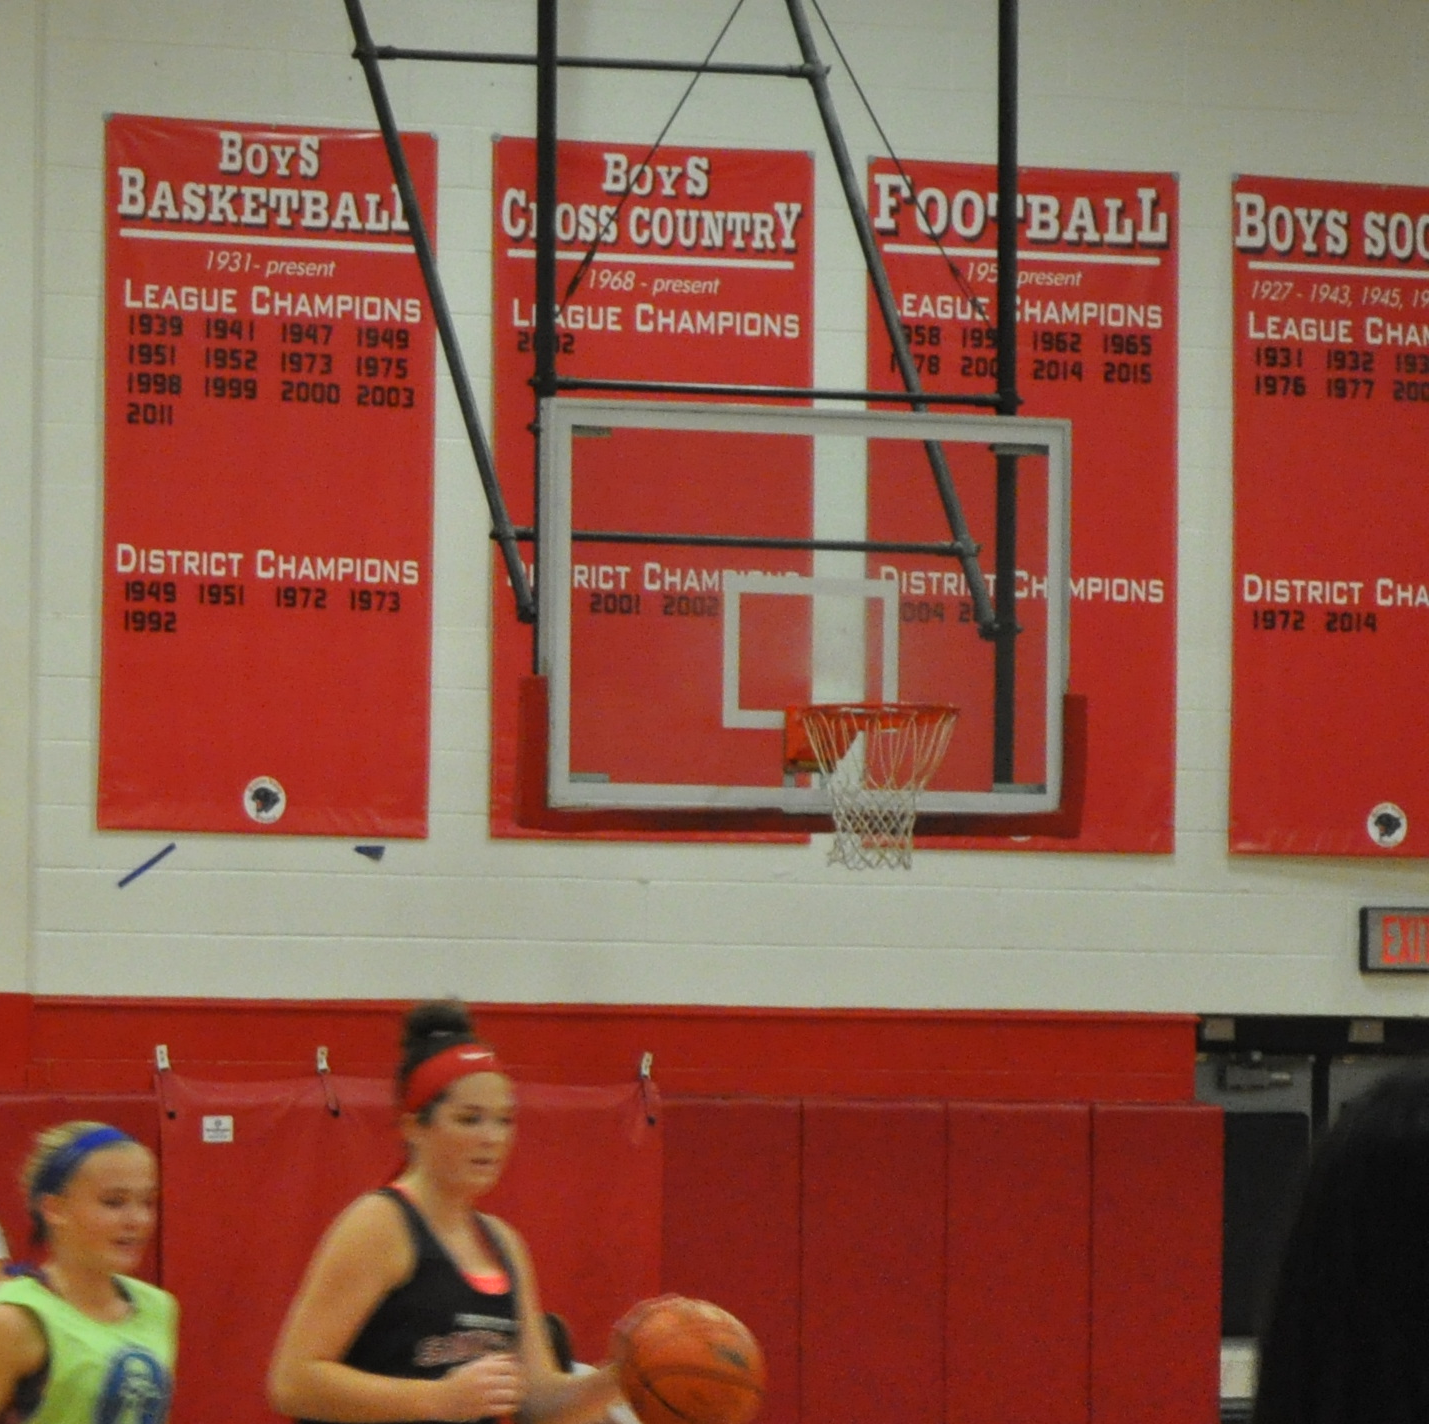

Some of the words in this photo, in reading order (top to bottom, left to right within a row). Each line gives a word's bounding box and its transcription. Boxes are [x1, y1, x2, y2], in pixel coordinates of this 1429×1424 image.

[218, 130, 321, 178] BOYS
[602, 152, 711, 197] BOYS
[629, 201, 802, 250] COUNTRY
[1235, 192, 1349, 256] BOYS
[265, 258, 337, 279] present
[590, 269, 636, 292] 1968
[652, 276, 720, 296] present
[125, 278, 238, 315] LEAGUE
[251, 285, 422, 324] CHAMPIONS
[896, 293, 990, 321] EAGUE
[1251, 280, 1294, 301] 1927
[129, 313, 184, 337] 1939
[206, 317, 255, 341] 1941
[281, 323, 333, 345] 1947
[357, 327, 410, 350] 1949
[635, 302, 800, 339] CHAMPIONS
[1248, 310, 1353, 344] LEAGUE
[517, 331, 575, 354] 22
[901, 324, 941, 346] 958
[1033, 331, 1083, 354] 1962
[1103, 333, 1153, 357] 1965
[128, 343, 176, 366] 1951
[205, 347, 258, 371] 1952
[281, 352, 333, 375] 1973
[357, 356, 408, 379] 1975
[890, 351, 941, 375] 178
[961, 355, 998, 377] 200
[1033, 359, 1083, 382] 2014
[1103, 362, 1153, 385] 2015
[1255, 347, 1303, 368] 1931
[1326, 350, 1375, 372] 1932
[127, 372, 182, 396] 1998
[205, 376, 258, 400] 1999
[281, 381, 341, 405] 2000
[356, 385, 415, 409] 2003
[1255, 375, 1307, 397] 1976
[1326, 378, 1376, 400] 1977
[127, 402, 174, 426] 2011
[116, 543, 244, 578] DISTRICT
[256, 550, 419, 585] CHAMPIONS
[125, 580, 177, 603] 1949
[199, 583, 245, 606] 1951
[276, 586, 327, 610] 1972
[350, 589, 401, 613] 1973
[1014, 569, 1164, 603] CHMPIONS
[1243, 573, 1363, 606] DISTRICT
[590, 592, 640, 615] 2001
[663, 594, 719, 617] 2002
[1252, 609, 1305, 632] 1972
[1325, 611, 1377, 633] 2014
[124, 610, 177, 633] 1992
